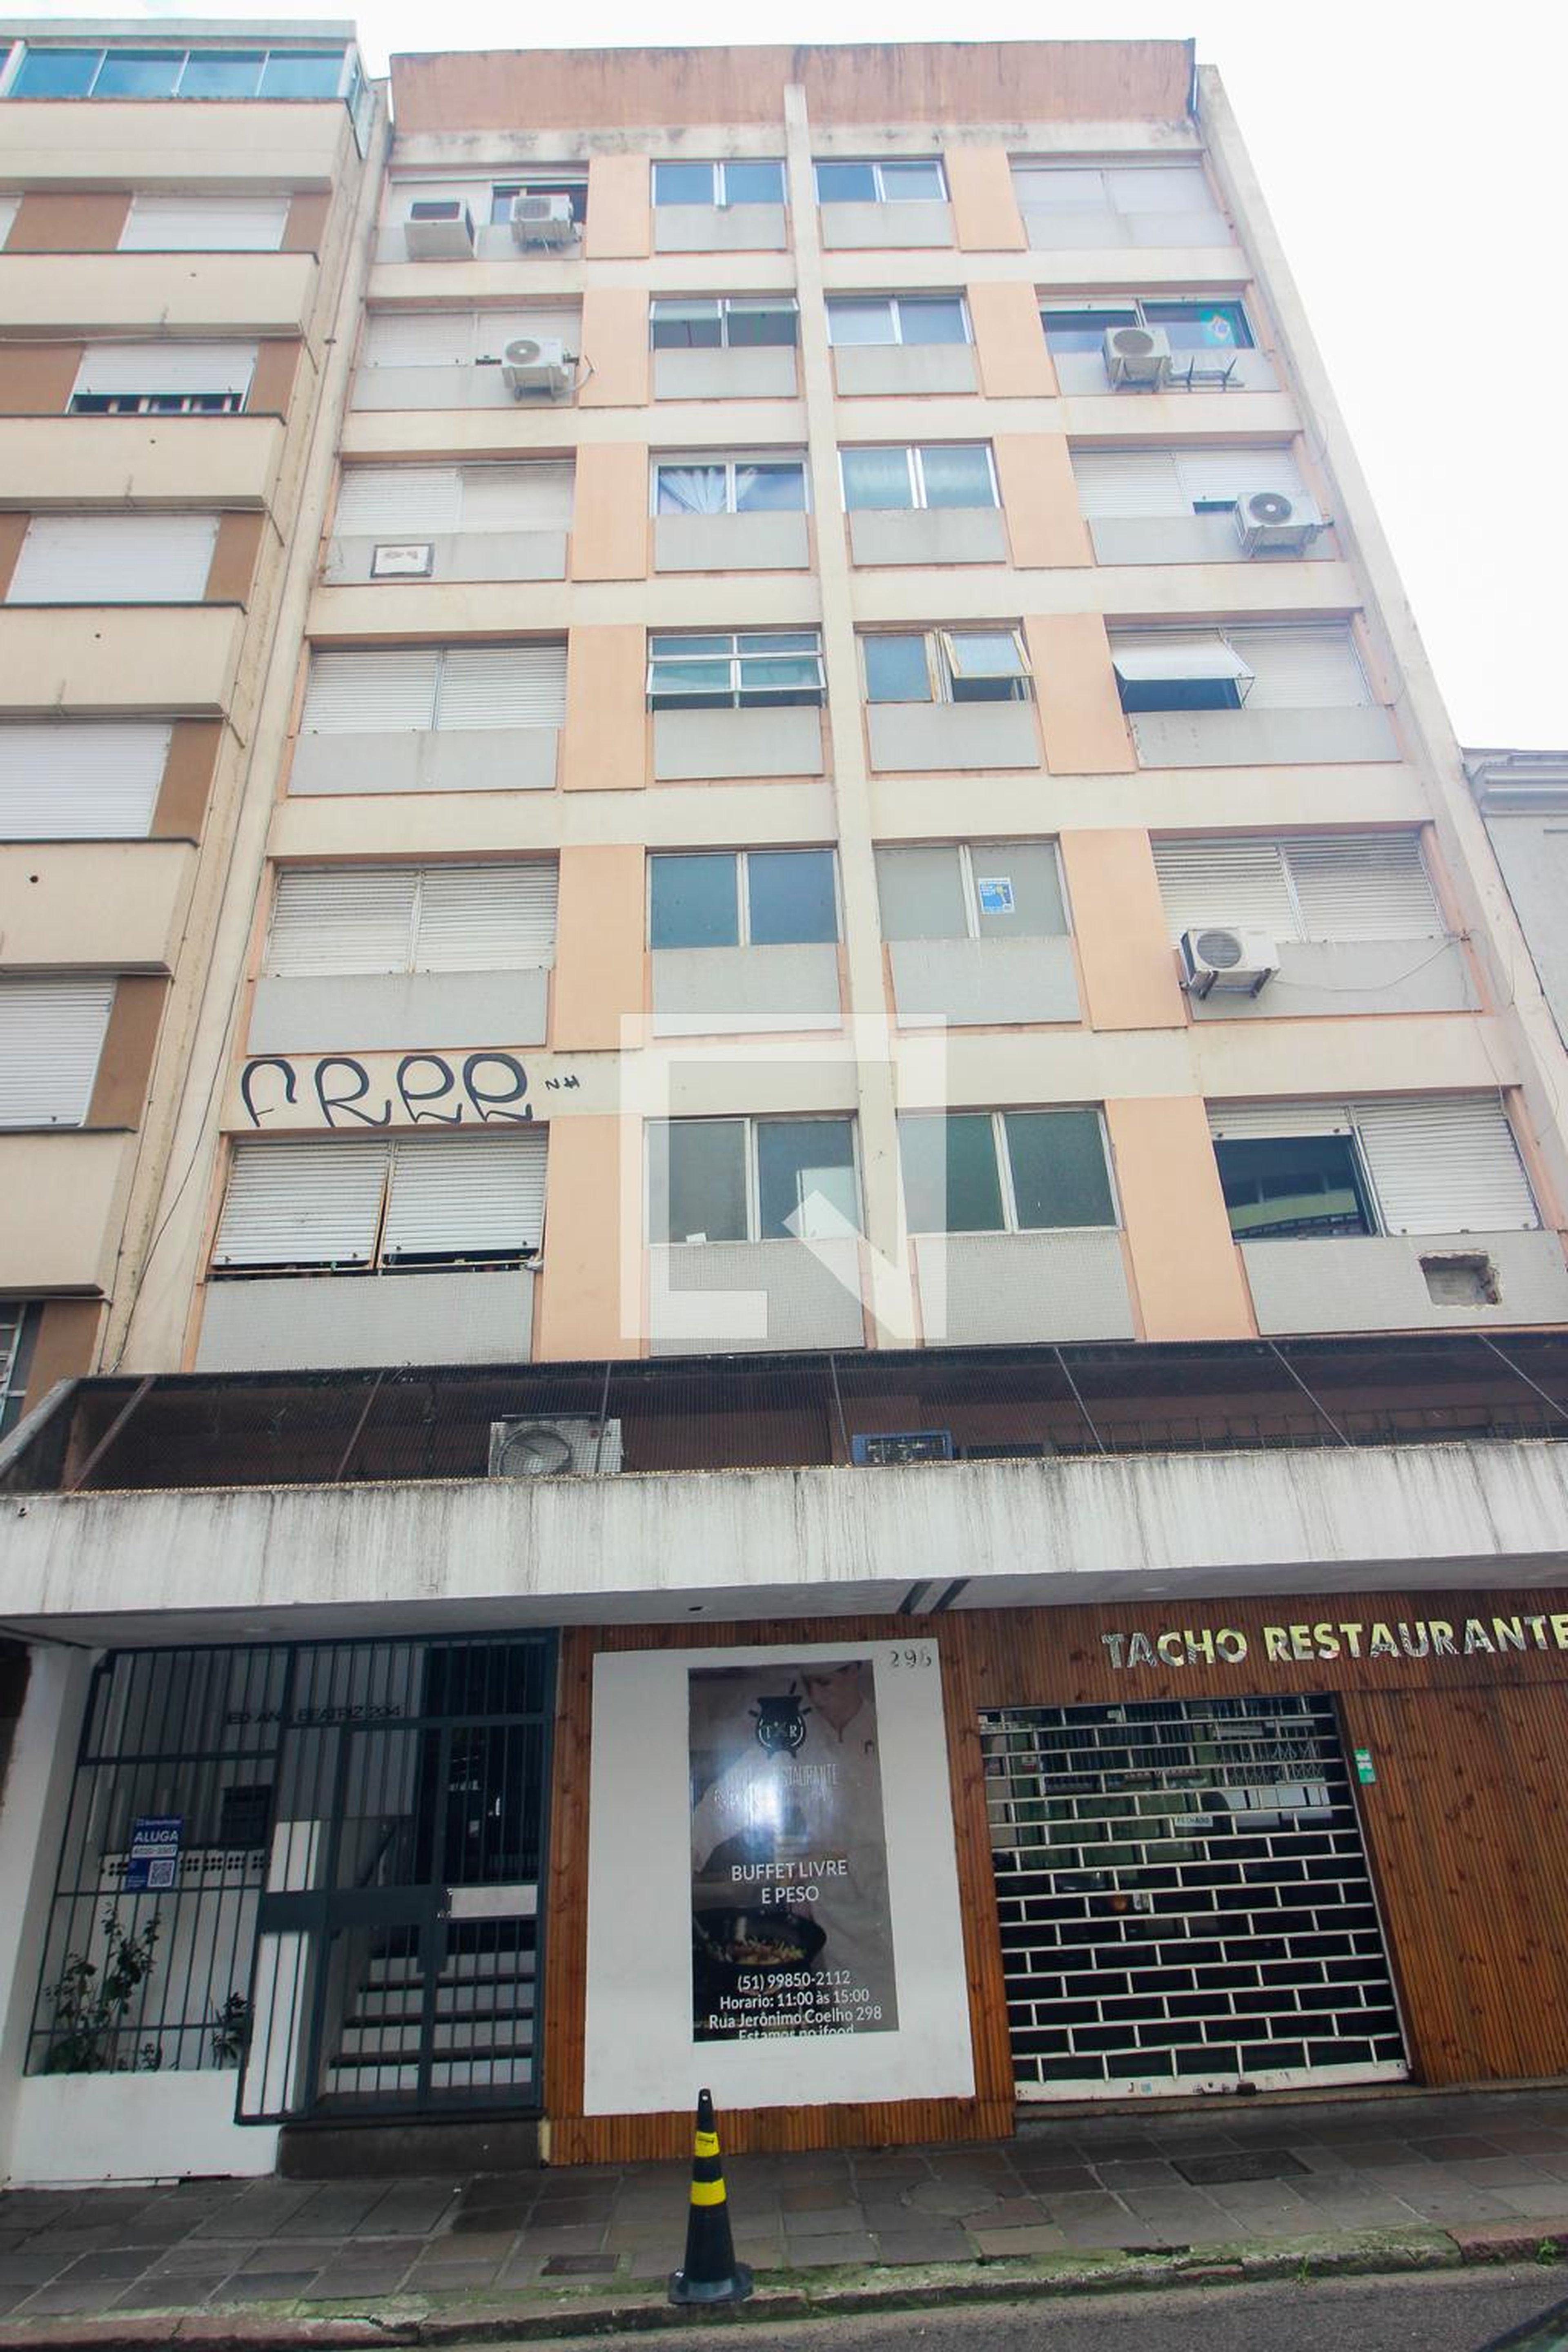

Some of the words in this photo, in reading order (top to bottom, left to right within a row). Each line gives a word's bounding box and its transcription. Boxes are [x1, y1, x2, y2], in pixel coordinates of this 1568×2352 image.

[1101, 1629, 1248, 1669] TACHO
[1262, 1614, 1568, 1663] RESTAURANTE
[134, 1830, 178, 1843] ALUGA
[731, 1863, 795, 1882] BUFFET
[799, 1860, 848, 1878] LIVRE
[762, 1887, 771, 1904] E
[775, 1886, 819, 1904] PESO
[737, 1974, 765, 1992] (51)
[767, 1970, 851, 1988] 99850-2112
[720, 1995, 774, 2010] Horario:
[777, 1992, 813, 2007] 11:00
[816, 1991, 830, 2005] às
[834, 1989, 870, 2004] 15:00
[709, 2015, 735, 2029] Rua
[736, 2010, 802, 2028] Jerônimo
[804, 2007, 853, 2024] Coelho
[856, 2006, 882, 2021] 298
